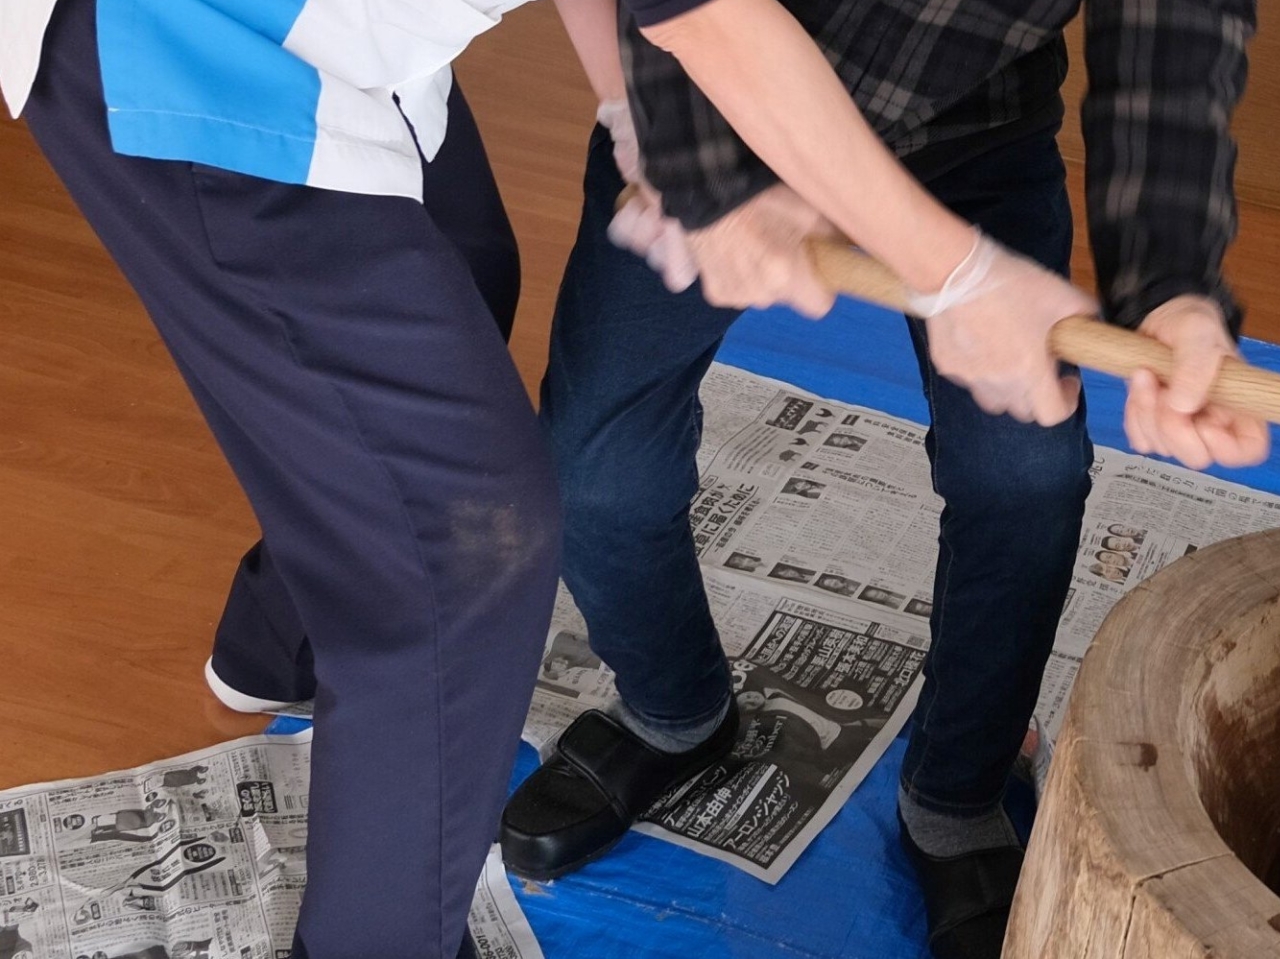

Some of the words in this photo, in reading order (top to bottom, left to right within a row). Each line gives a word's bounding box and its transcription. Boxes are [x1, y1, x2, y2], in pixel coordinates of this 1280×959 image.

[685, 784, 734, 839] 山本由伸
[721, 769, 790, 850] アーロン・ジャッジ
